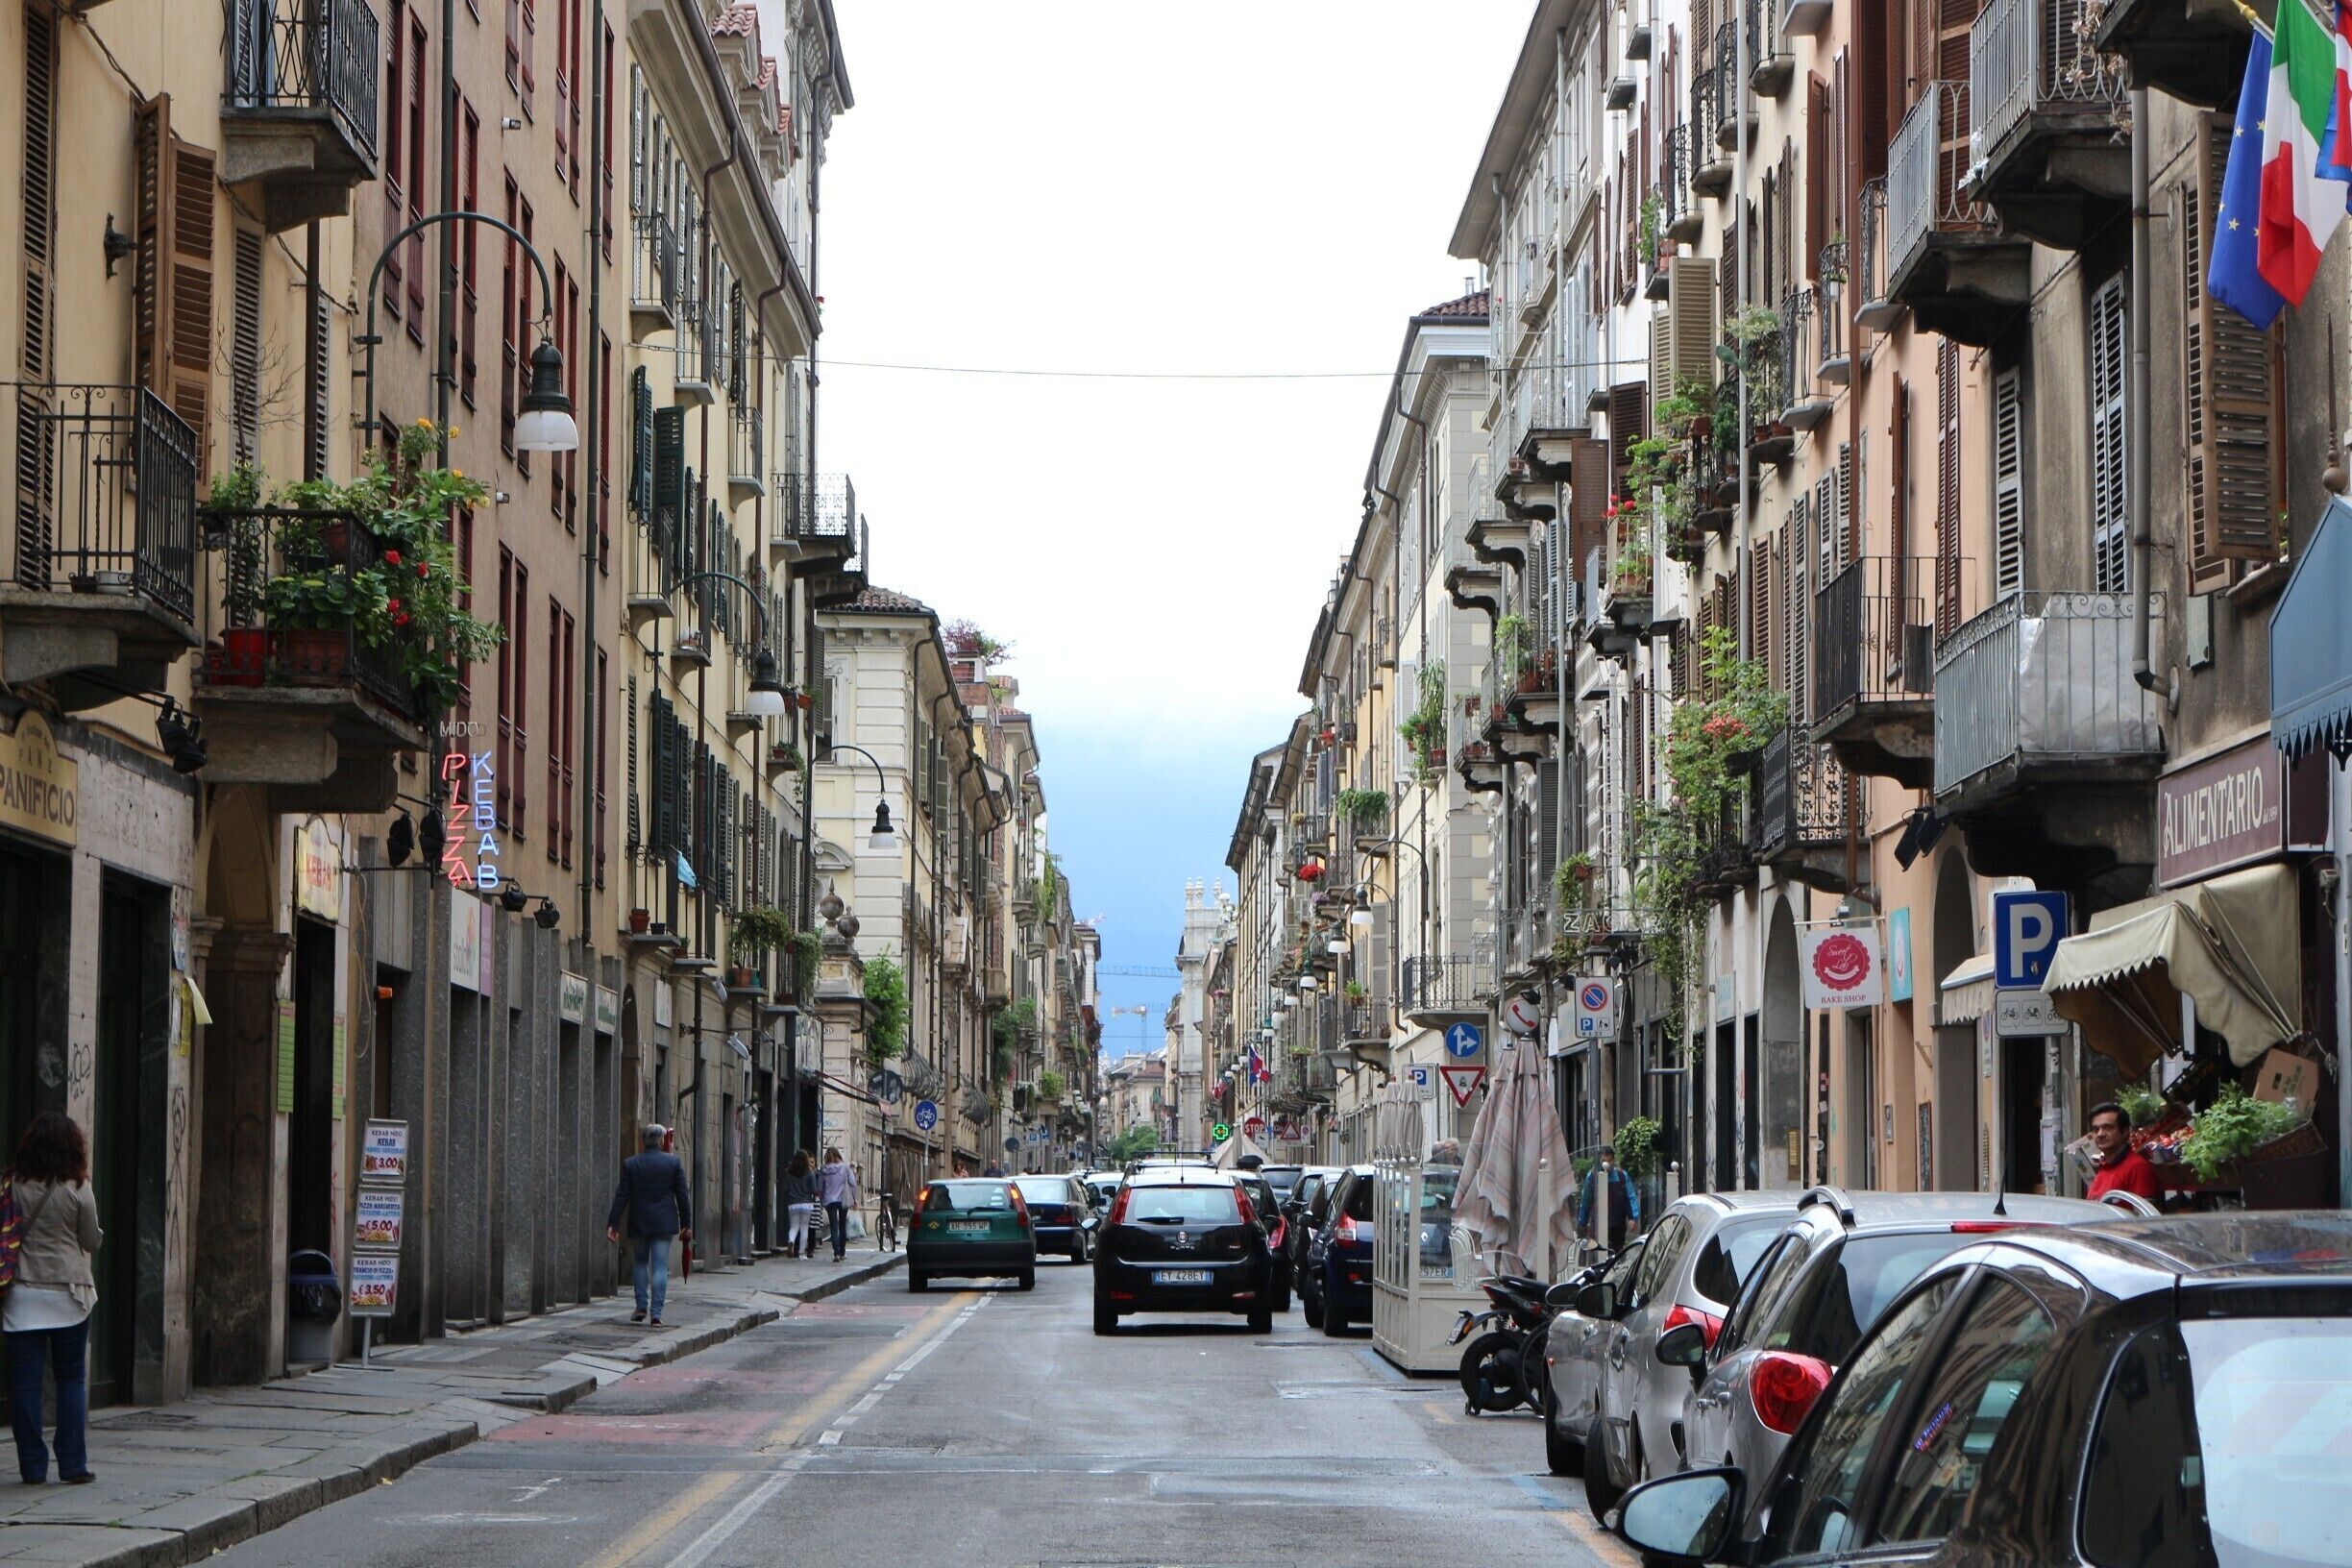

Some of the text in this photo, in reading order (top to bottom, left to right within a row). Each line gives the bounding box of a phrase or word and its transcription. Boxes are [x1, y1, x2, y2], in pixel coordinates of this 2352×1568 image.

[442, 753, 472, 886] PIZZA
[471, 751, 500, 889] KEBAB
[2164, 767, 2264, 858] ALIMENTARIO
[2010, 903, 2053, 978] P
[1821, 995, 1842, 1004] BAKE
[1582, 1019, 1591, 1029] P
[1245, 1124, 1264, 1133] STOP
[1161, 1270, 1172, 1281] EY
